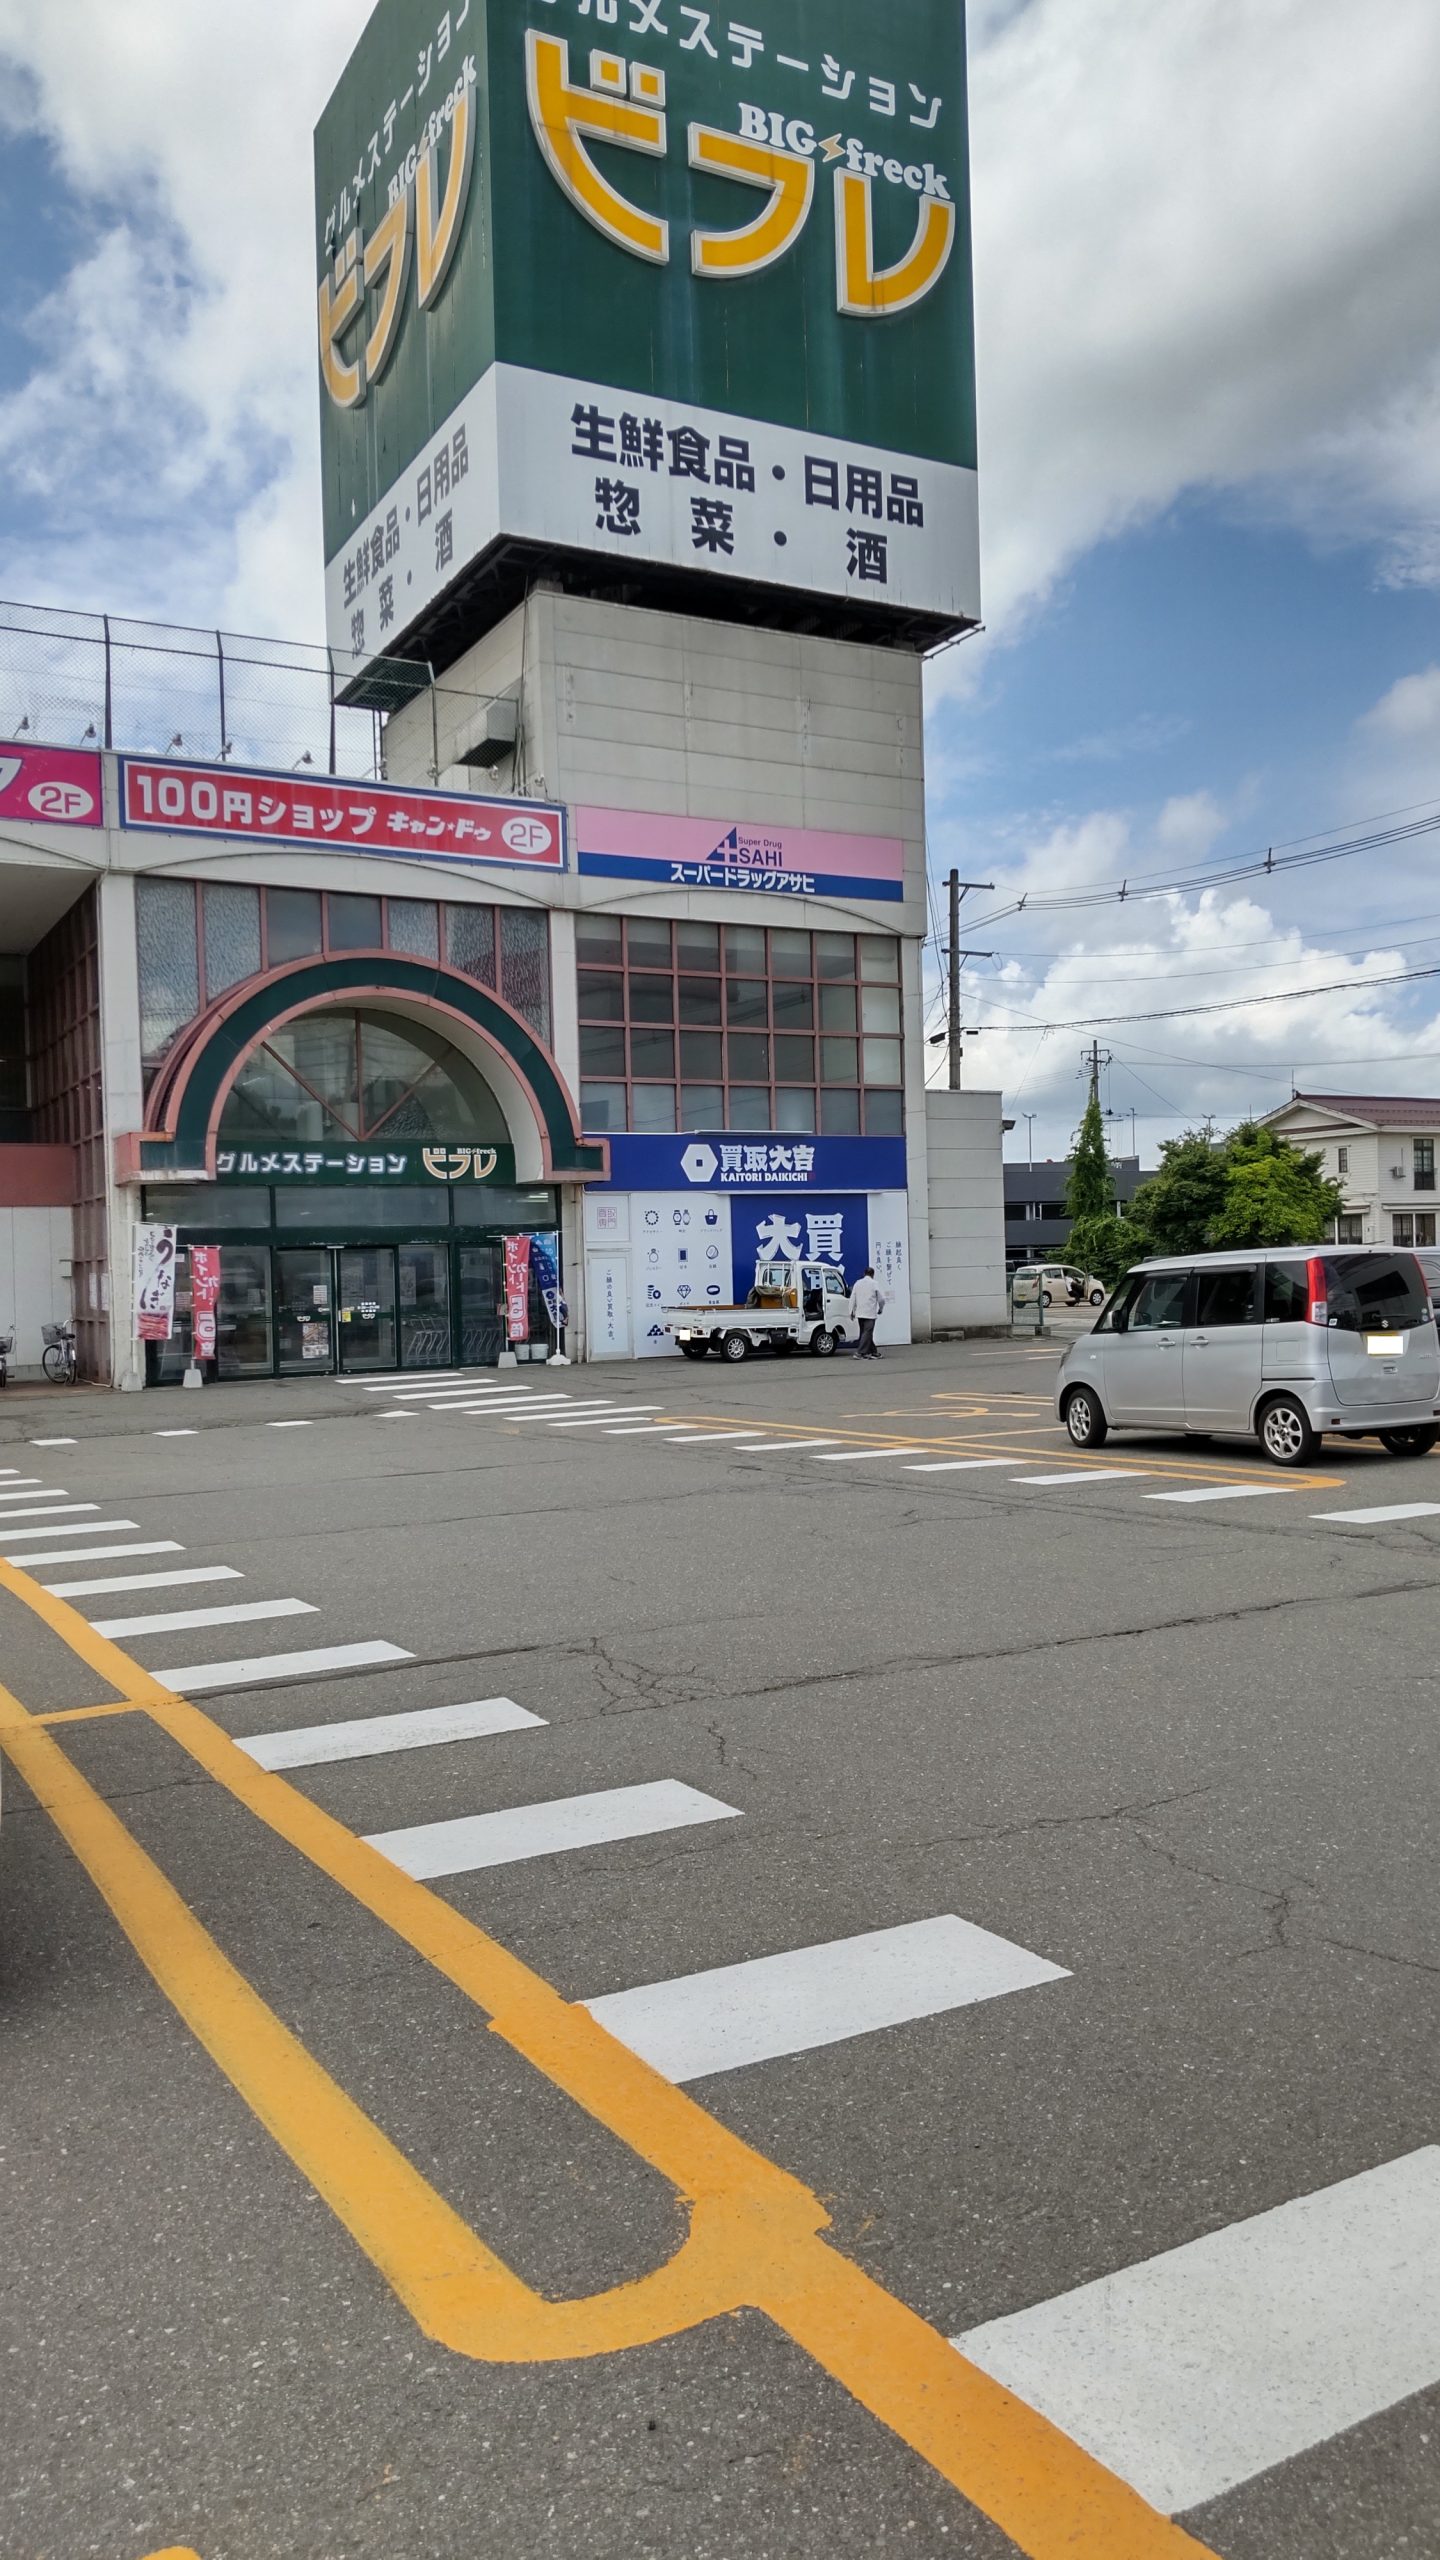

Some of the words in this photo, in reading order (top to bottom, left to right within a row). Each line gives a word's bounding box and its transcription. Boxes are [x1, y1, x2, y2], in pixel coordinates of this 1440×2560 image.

[388, 152, 419, 208] BIG
[428, 54, 477, 148] freck
[738, 102, 817, 155] BIG
[846, 138, 950, 199] freck
[525, 28, 956, 317] ビフレ
[570, 403, 924, 528] 生鮮食品・日用品
[343, 423, 469, 610] 生鮮食品・日用品
[40, 785, 82, 814] 2F
[136, 775, 377, 836] 100円ショップ
[510, 823, 544, 849] 2F
[738, 836, 761, 847] Super
[763, 839, 783, 850] Drug
[670, 862, 816, 893] スーパードラッグアサヒ
[216, 1152, 406, 1174] グルメステーション
[422, 1147, 498, 1180] ビフレ
[719, 1144, 816, 1173] 買取大吉
[720, 1172, 763, 1183] KAITORI
[764, 1172, 808, 1183] DAIKICHI
